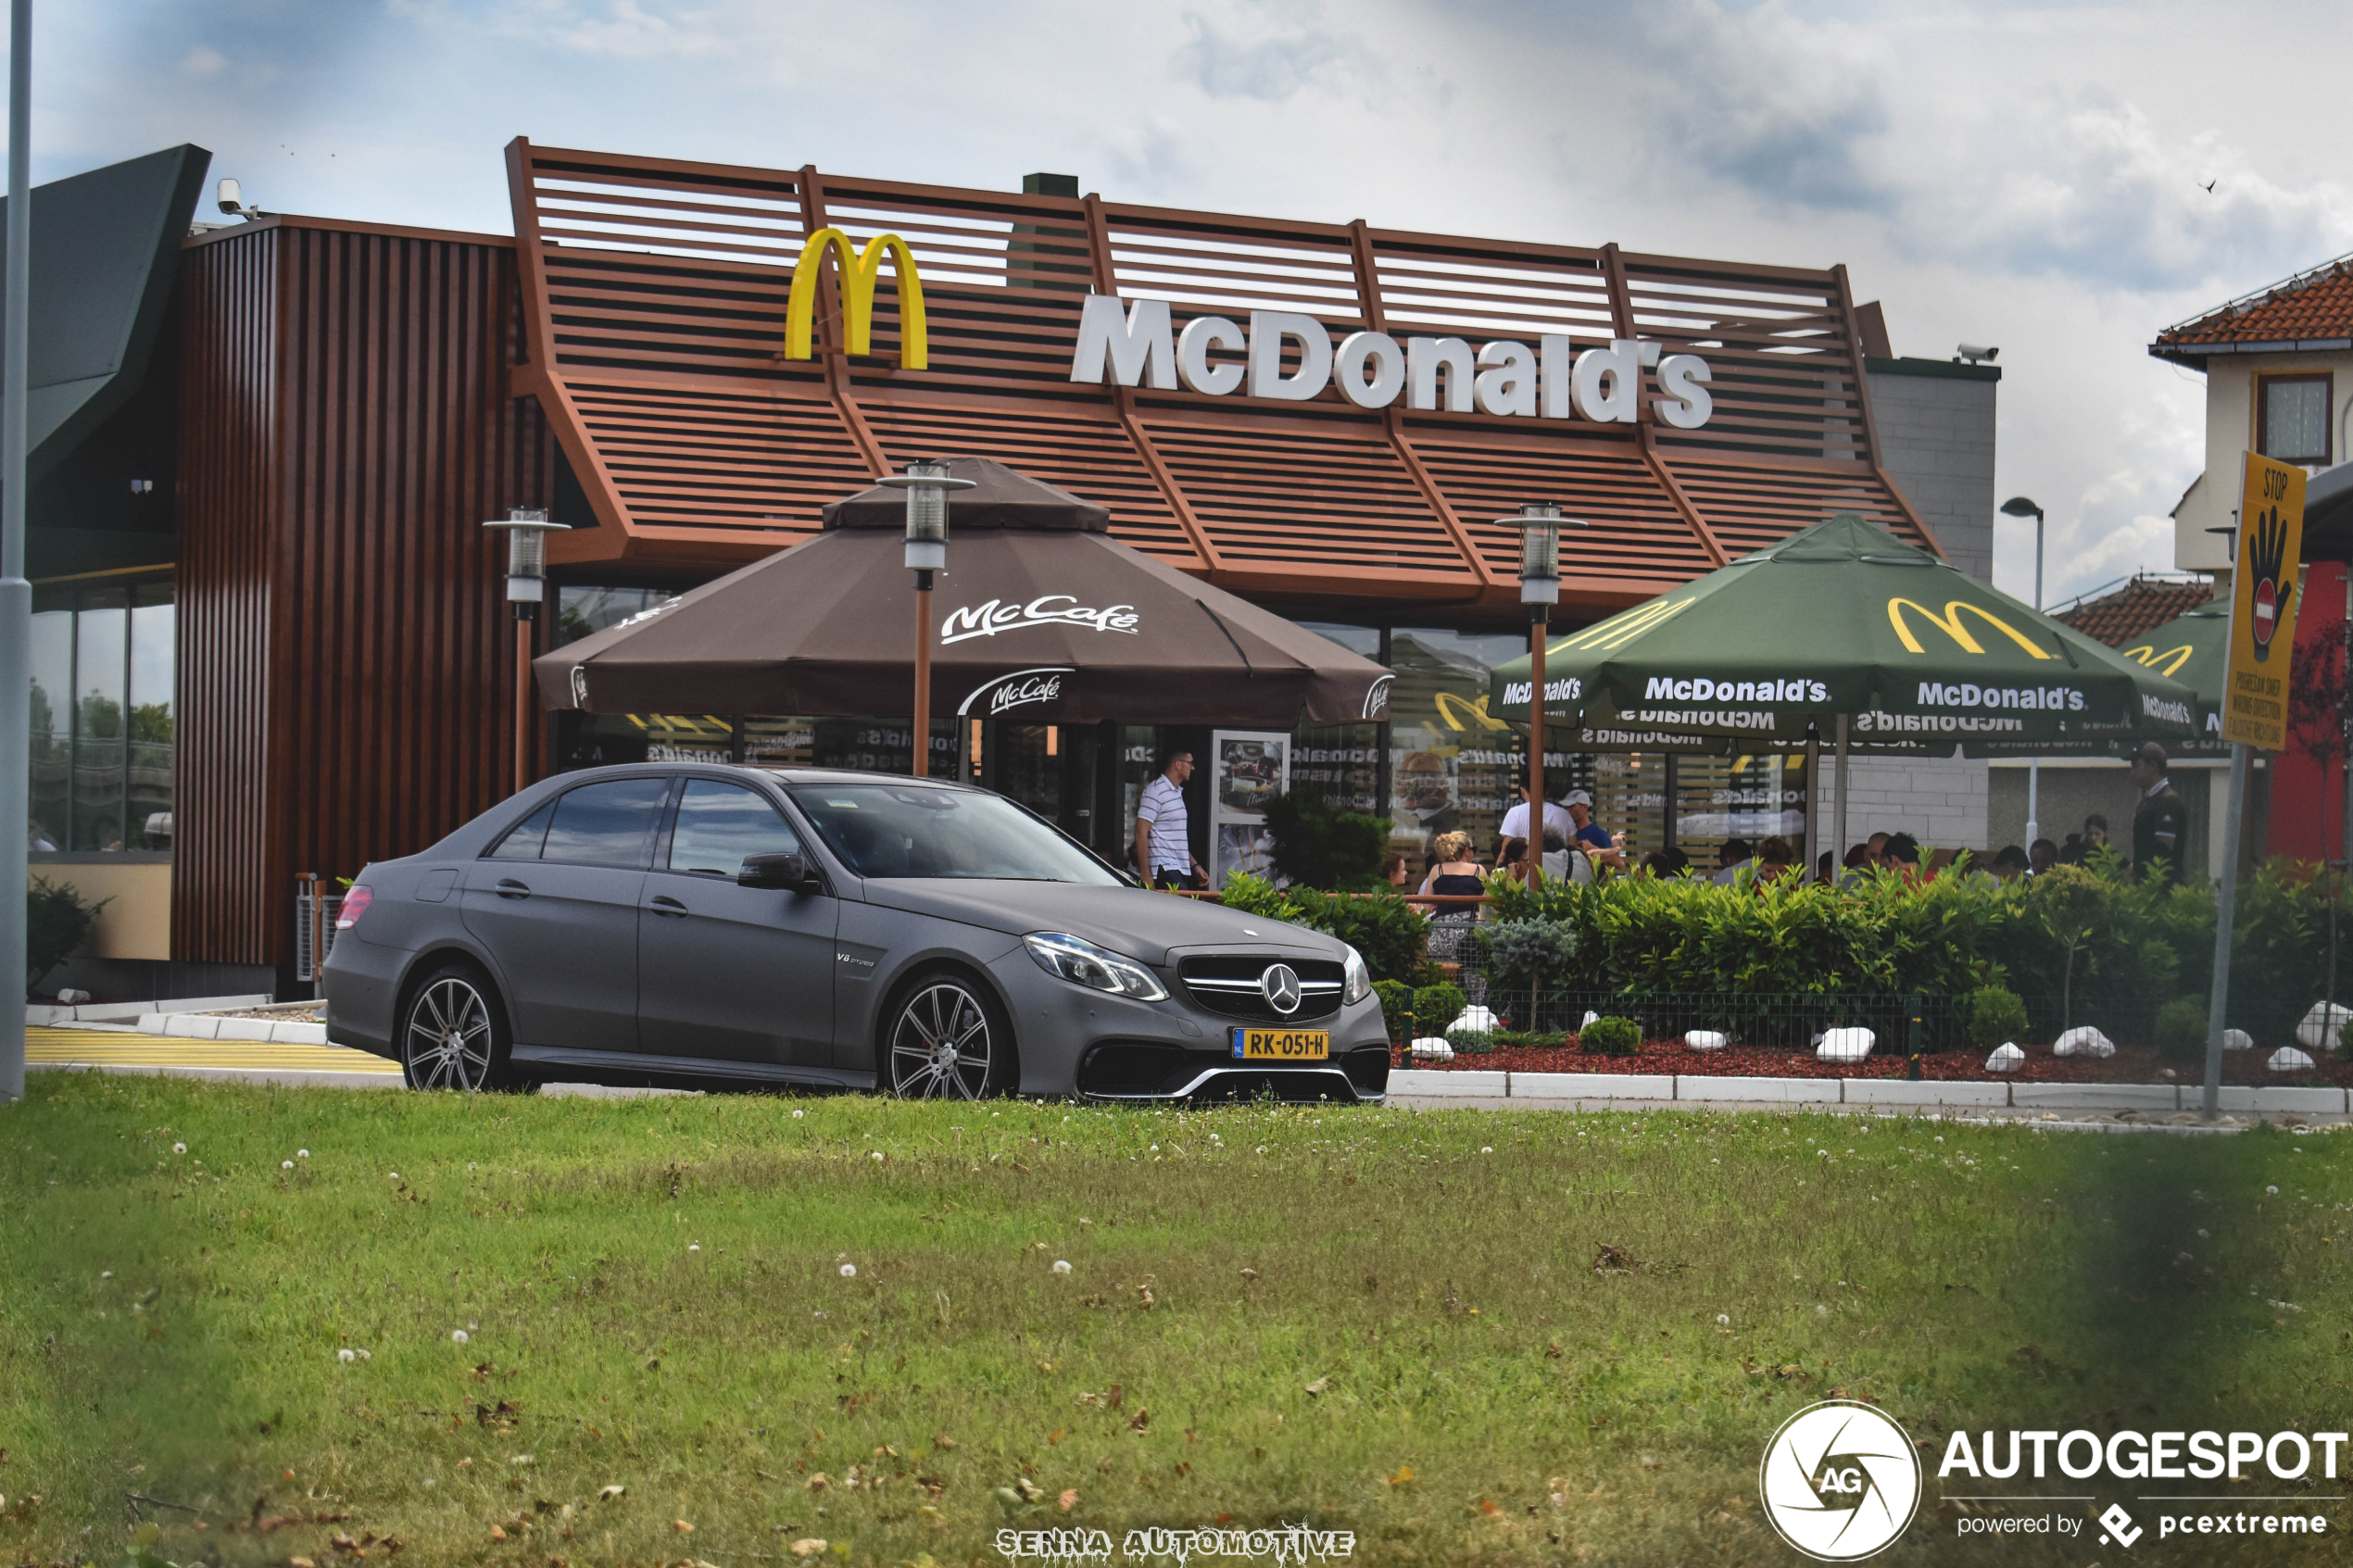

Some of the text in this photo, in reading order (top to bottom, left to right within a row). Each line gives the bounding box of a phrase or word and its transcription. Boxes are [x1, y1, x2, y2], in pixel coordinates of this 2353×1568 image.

[1070, 294, 1713, 429] McDonald's
[2263, 467, 2288, 502] STOP
[991, 675, 1061, 711] McCafé
[1503, 677, 1581, 706] McDnald's
[1644, 677, 1827, 702] McDonald's
[1917, 682, 2084, 711] McDonald's
[2142, 694, 2191, 724] McDonald's
[837, 952, 850, 962] V8
[1234, 1046, 1243, 1054] NL
[1251, 1033, 1323, 1055] RK-051-H
